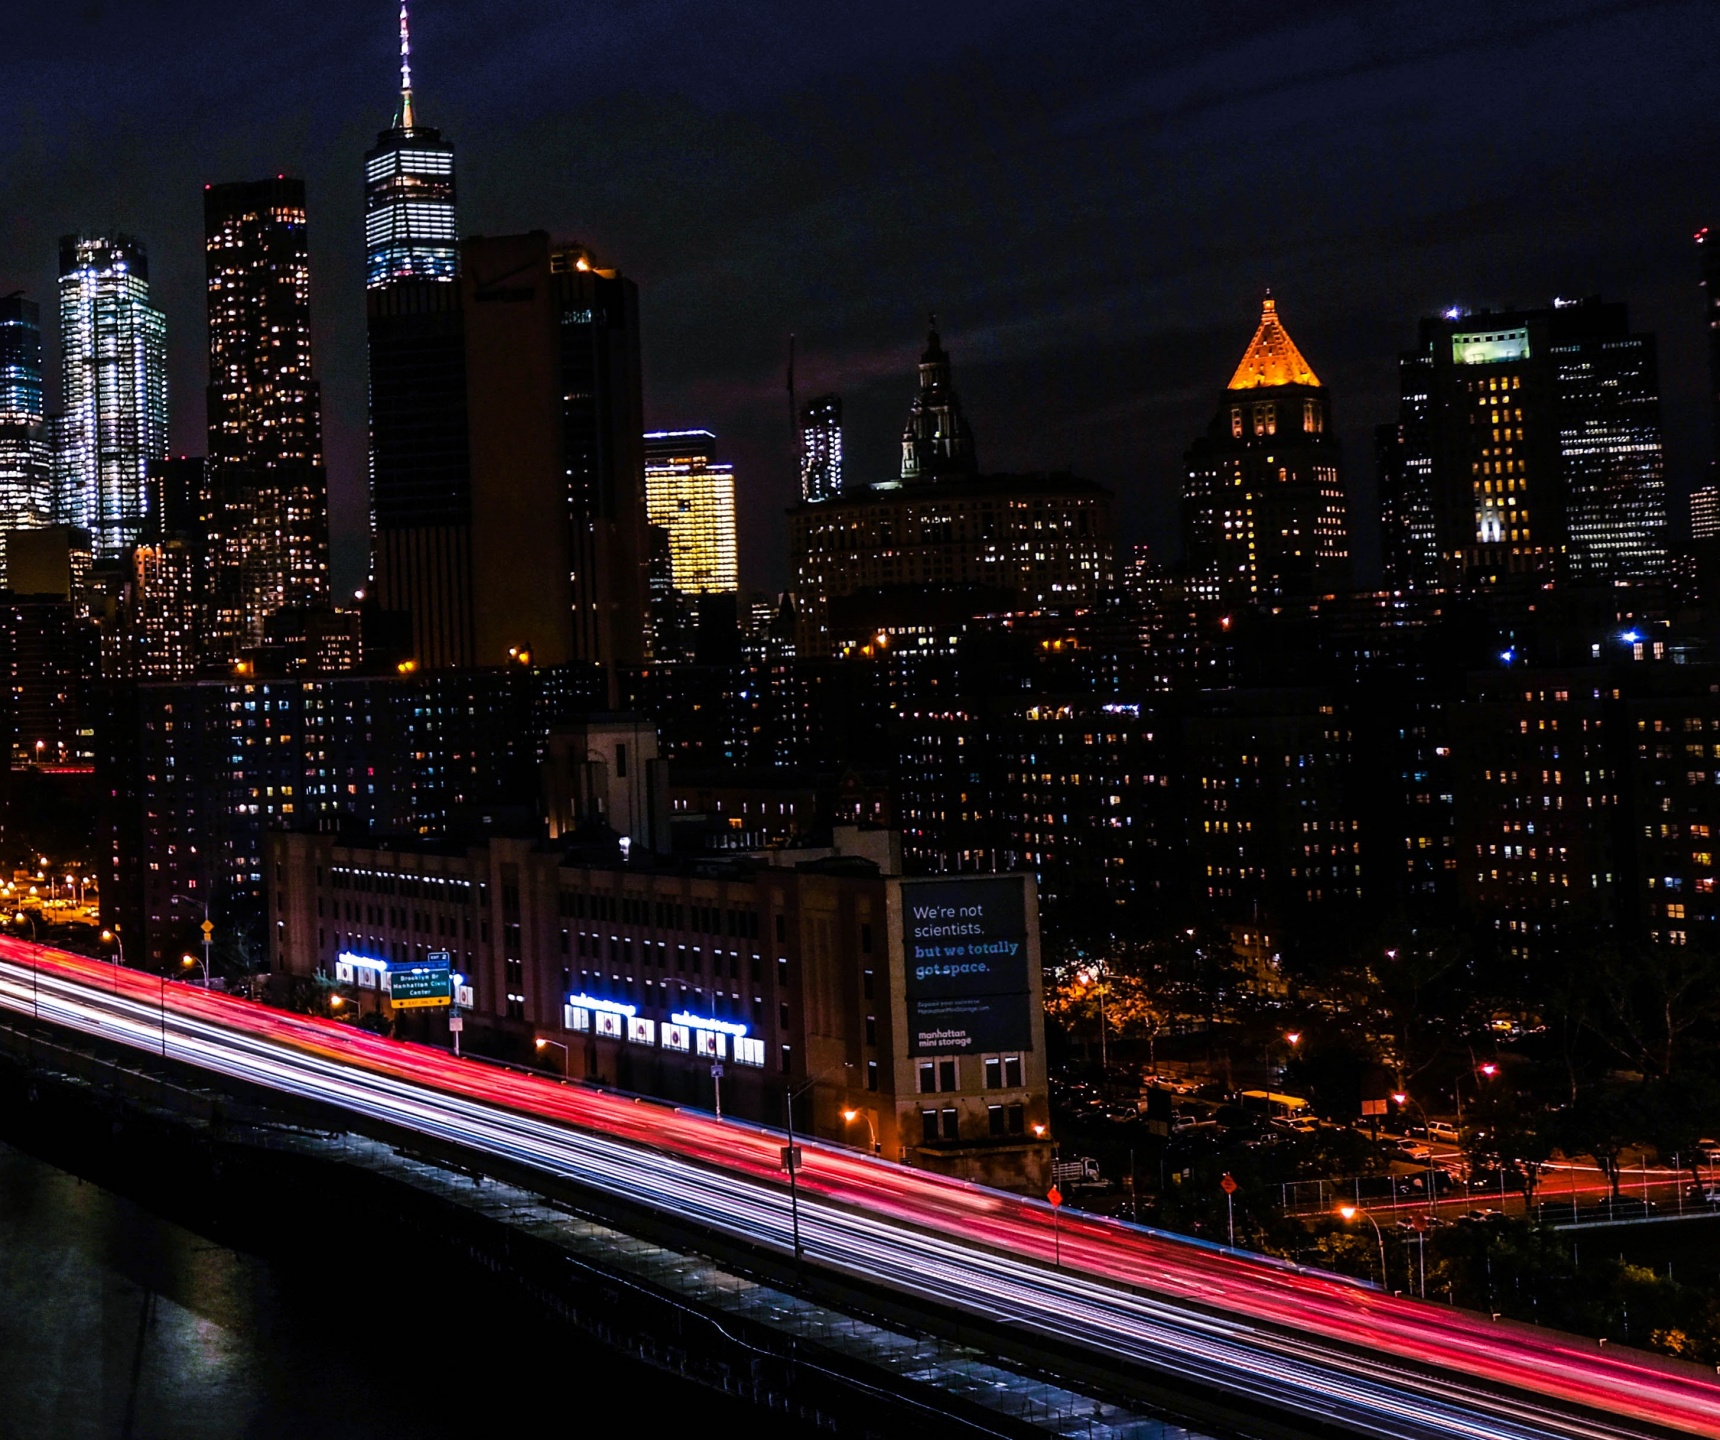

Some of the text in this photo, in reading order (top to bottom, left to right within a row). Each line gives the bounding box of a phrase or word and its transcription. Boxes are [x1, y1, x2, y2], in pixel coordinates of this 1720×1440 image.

[913, 904, 983, 919] We're not
[915, 941, 1019, 958] but we totally
[916, 962, 990, 980] got space.
[918, 1028, 966, 1039] manhattan
[918, 1037, 972, 1048] mini storage
